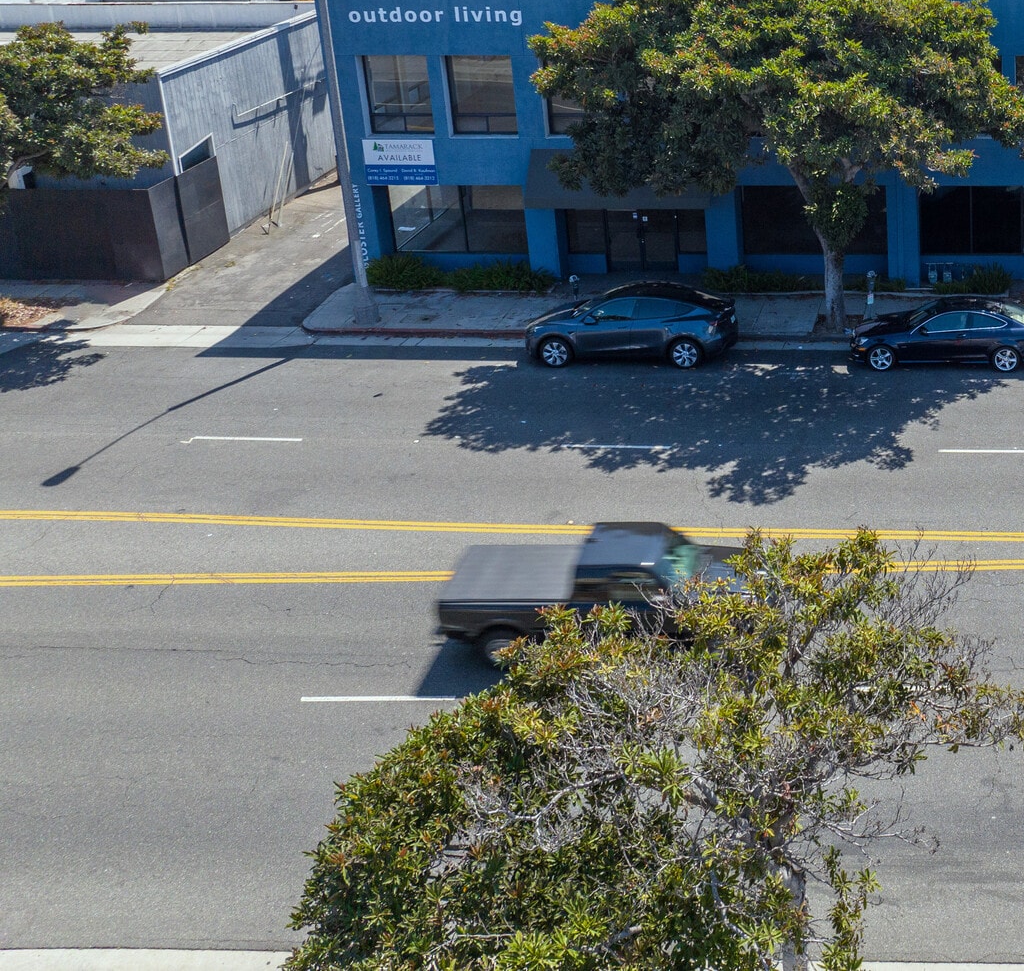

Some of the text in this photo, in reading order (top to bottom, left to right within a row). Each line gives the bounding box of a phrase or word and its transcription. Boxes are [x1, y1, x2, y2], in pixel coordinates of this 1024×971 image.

[349, 6, 523, 26] outdoor living
[378, 154, 422, 162] AVAILABLE
[352, 184, 363, 219] GALLERY
